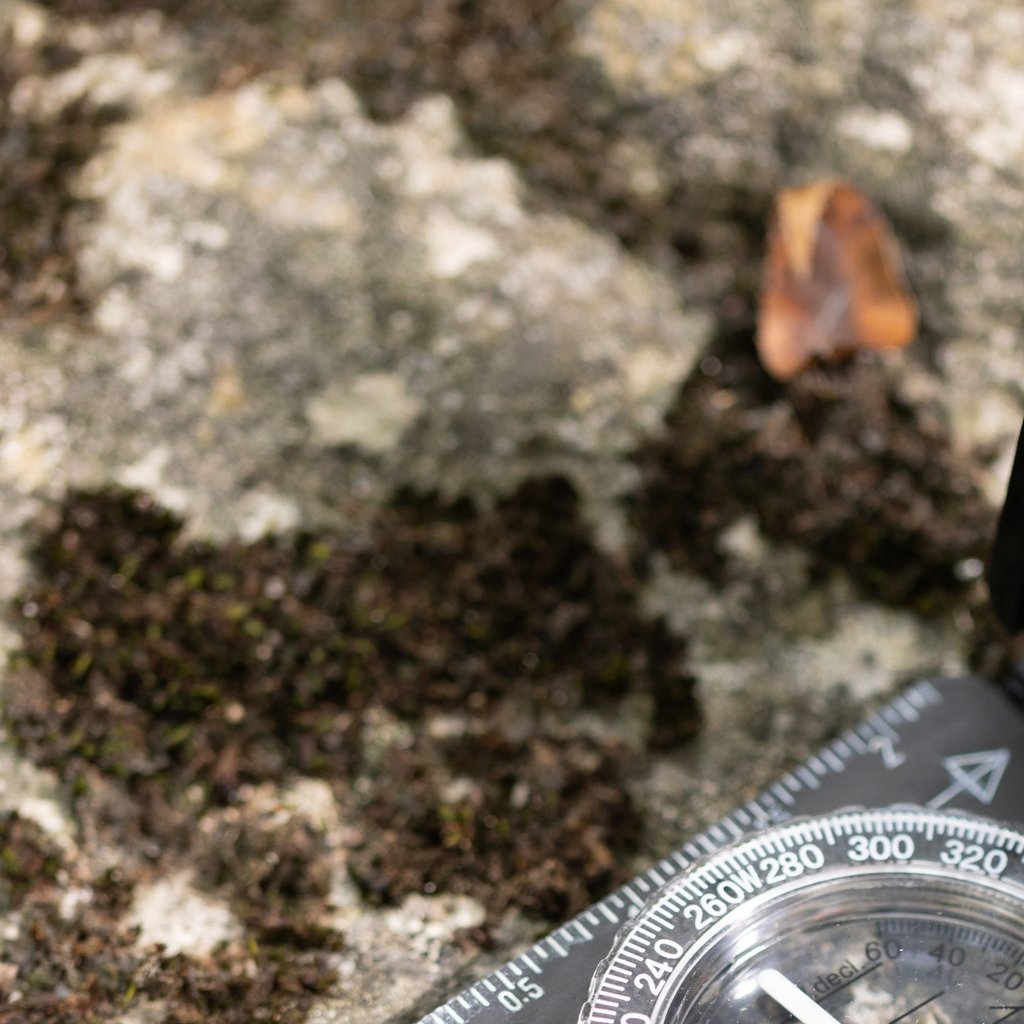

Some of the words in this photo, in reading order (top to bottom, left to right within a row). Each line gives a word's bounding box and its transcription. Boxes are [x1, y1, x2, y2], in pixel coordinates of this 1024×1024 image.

[848, 834, 914, 861] 300
[940, 840, 1008, 875] 320
[730, 864, 763, 894] W
[759, 844, 824, 885] 280
[683, 880, 745, 930] 260
[865, 939, 900, 961] 60
[929, 943, 965, 968] 40
[634, 938, 684, 996] 240
[985, 963, 1024, 990] 20
[497, 976, 545, 1012] 0.5
